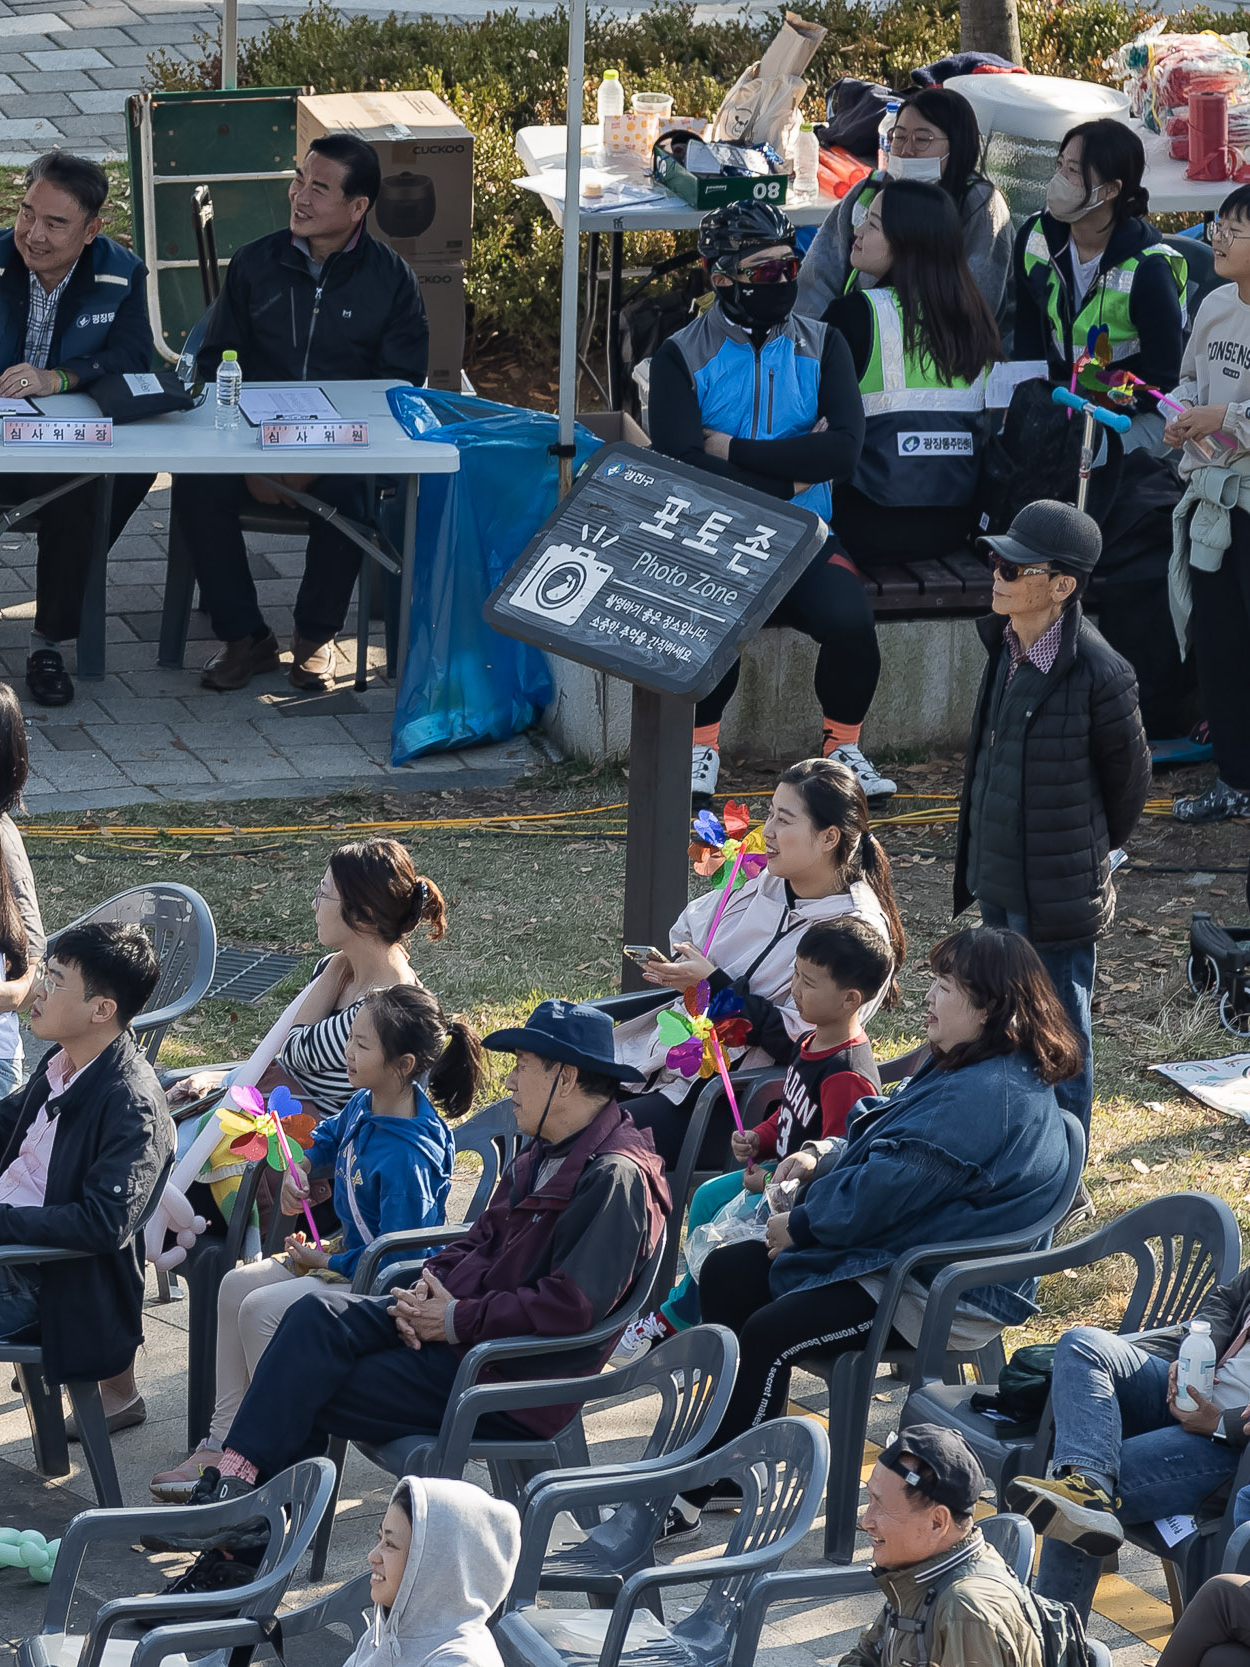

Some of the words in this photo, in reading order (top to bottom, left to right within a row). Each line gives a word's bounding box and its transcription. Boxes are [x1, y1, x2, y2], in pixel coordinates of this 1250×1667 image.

[412, 144, 465, 155] CUCKOO
[752, 181, 780, 200] 08
[623, 468, 655, 487] 광진구
[638, 494, 779, 576] 포토존
[632, 550, 689, 588] Photo
[692, 571, 740, 607] Zone
[605, 593, 644, 618] 촬영하기
[642, 607, 662, 625] 좋은
[589, 615, 620, 635] 소중한
[618, 625, 647, 646] 추억을
[781, 1338, 822, 1359] beautiful
[820, 1327, 858, 1343] women
[762, 1366, 778, 1397] secret
[752, 1398, 769, 1427] makes
